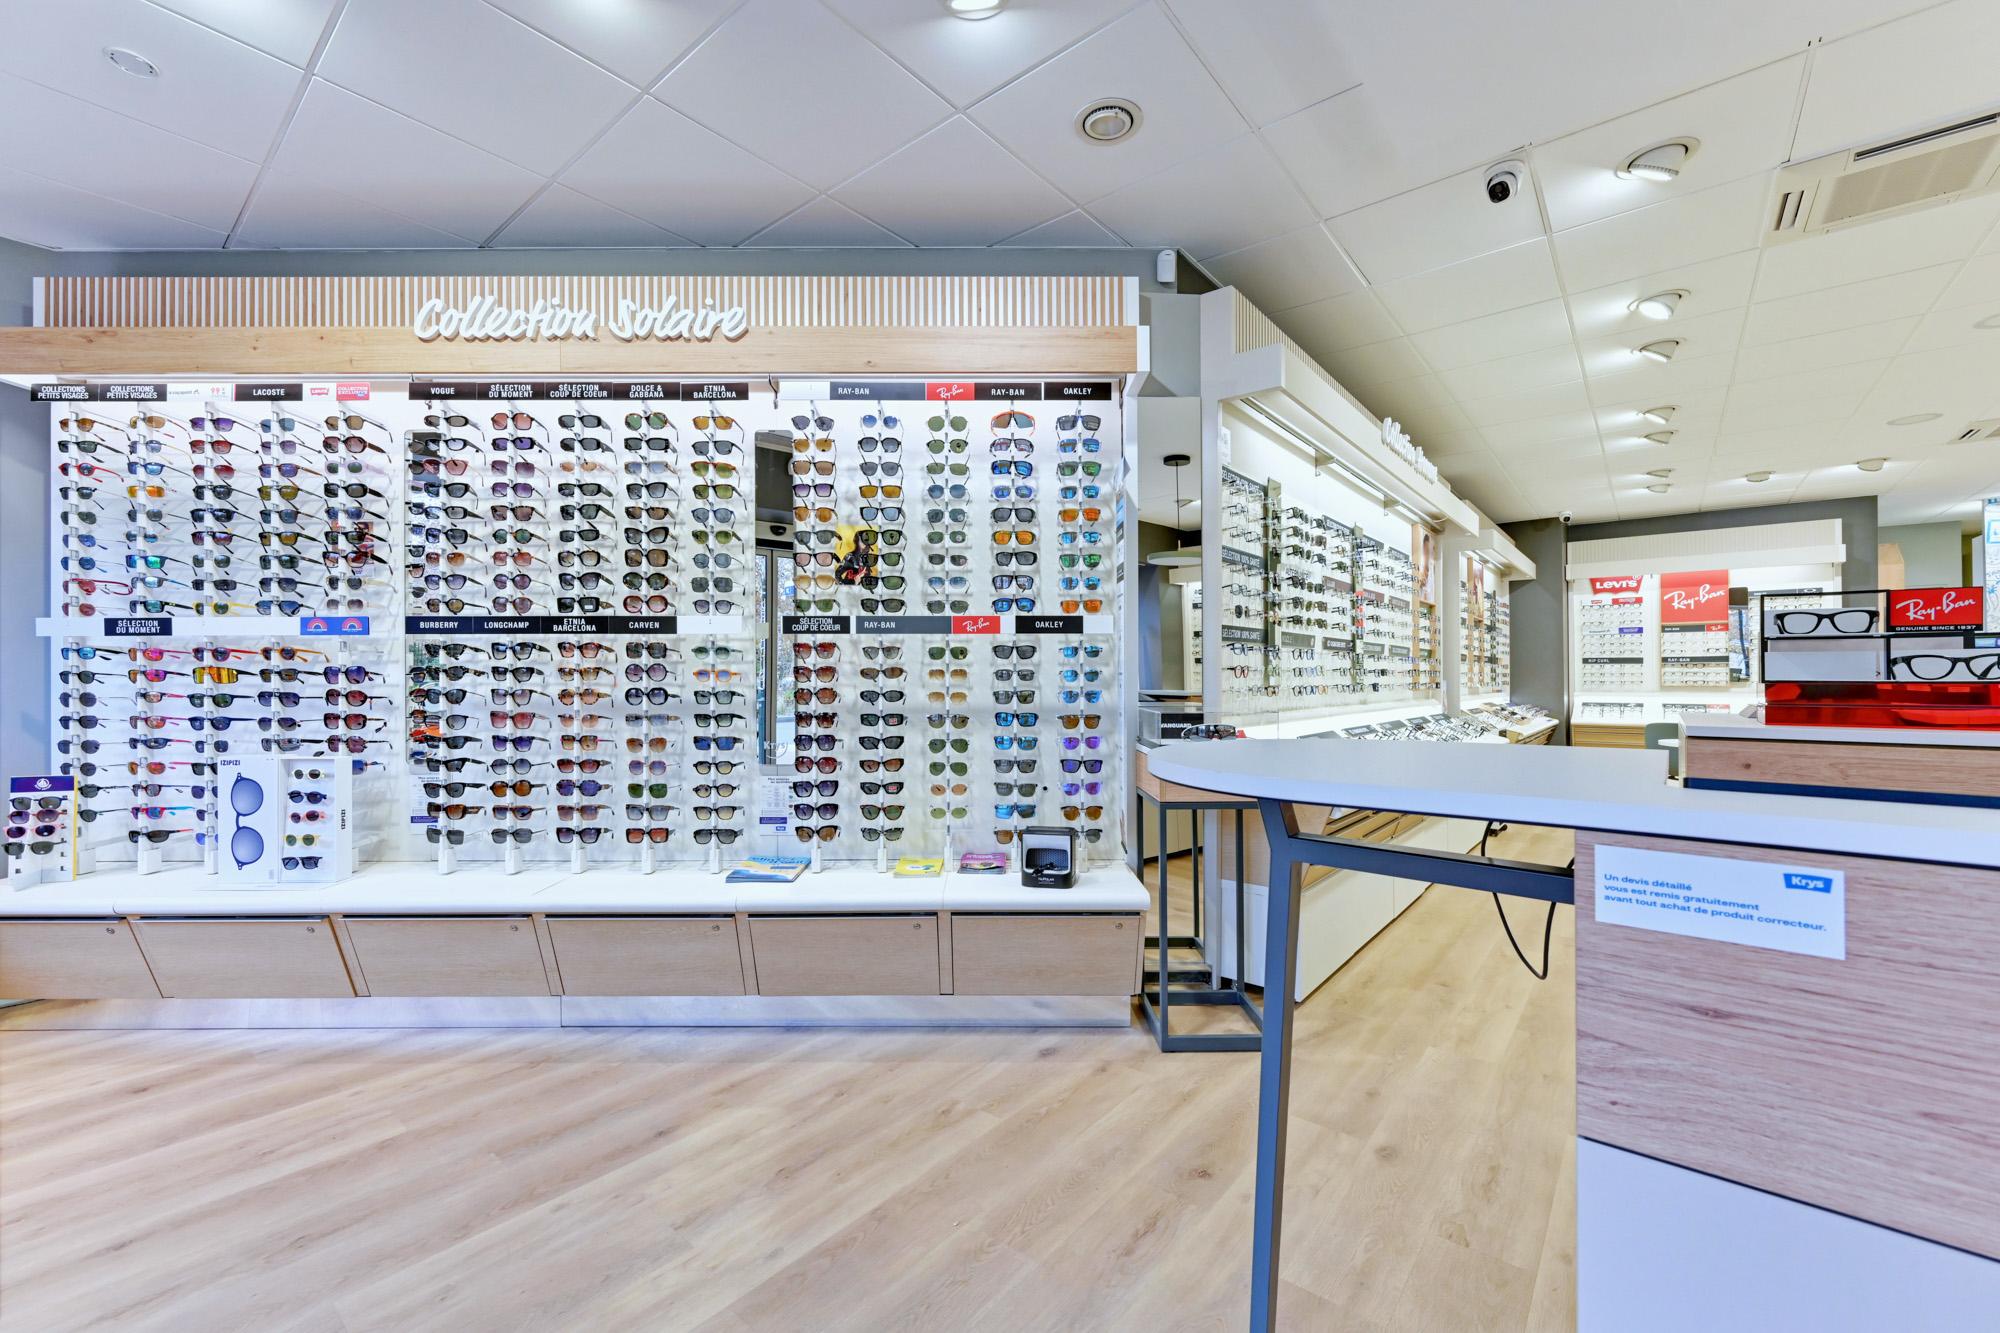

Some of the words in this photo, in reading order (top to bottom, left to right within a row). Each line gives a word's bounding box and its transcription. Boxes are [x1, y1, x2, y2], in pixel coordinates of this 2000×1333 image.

[414, 295, 597, 341] Collection
[608, 294, 747, 342] Solaire
[430, 387, 455, 395] VOGUE
[490, 383, 532, 392] SÉLECTION
[558, 383, 599, 392] SÉLECTION
[936, 384, 964, 399] Ray-Ban
[1063, 387, 1092, 395] OAKLEY
[991, 388, 1025, 396] RAY-BAN
[1664, 584, 1726, 609] Ray-Ban
[1895, 591, 1976, 621] Ray-Ban
[118, 619, 159, 627] SÉLECTION
[420, 621, 459, 629] BURBERRY
[484, 621, 530, 629] LONGCHAMP
[628, 621, 660, 629] CARVEN
[799, 617, 833, 625] SÉLECTION
[864, 621, 896, 629] RAY-BAN
[962, 617, 990, 632] Ray-Ban
[116, 626, 127, 634] DU
[128, 626, 161, 634] MOMENT
[553, 624, 597, 632] BARCELONA
[791, 624, 809, 632] COUP
[810, 624, 819, 632] DE
[820, 624, 841, 632] COEUR
[1604, 873, 1619, 883] Un
[1621, 875, 1650, 887] devis
[1651, 878, 1693, 892] détaillé
[1790, 875, 1825, 890] Krys
[1604, 885, 1628, 894] vous
[1631, 887, 1647, 896] est
[1649, 889, 1681, 901] remis
[1682, 893, 1760, 912] gratuitement
[1604, 895, 1634, 905] avant
[1635, 897, 1658, 907] tout
[1660, 900, 1692, 913] achat
[1694, 904, 1709, 915] de
[1710, 908, 1755, 923] produit
[1756, 913, 1828, 932] correcteur.
